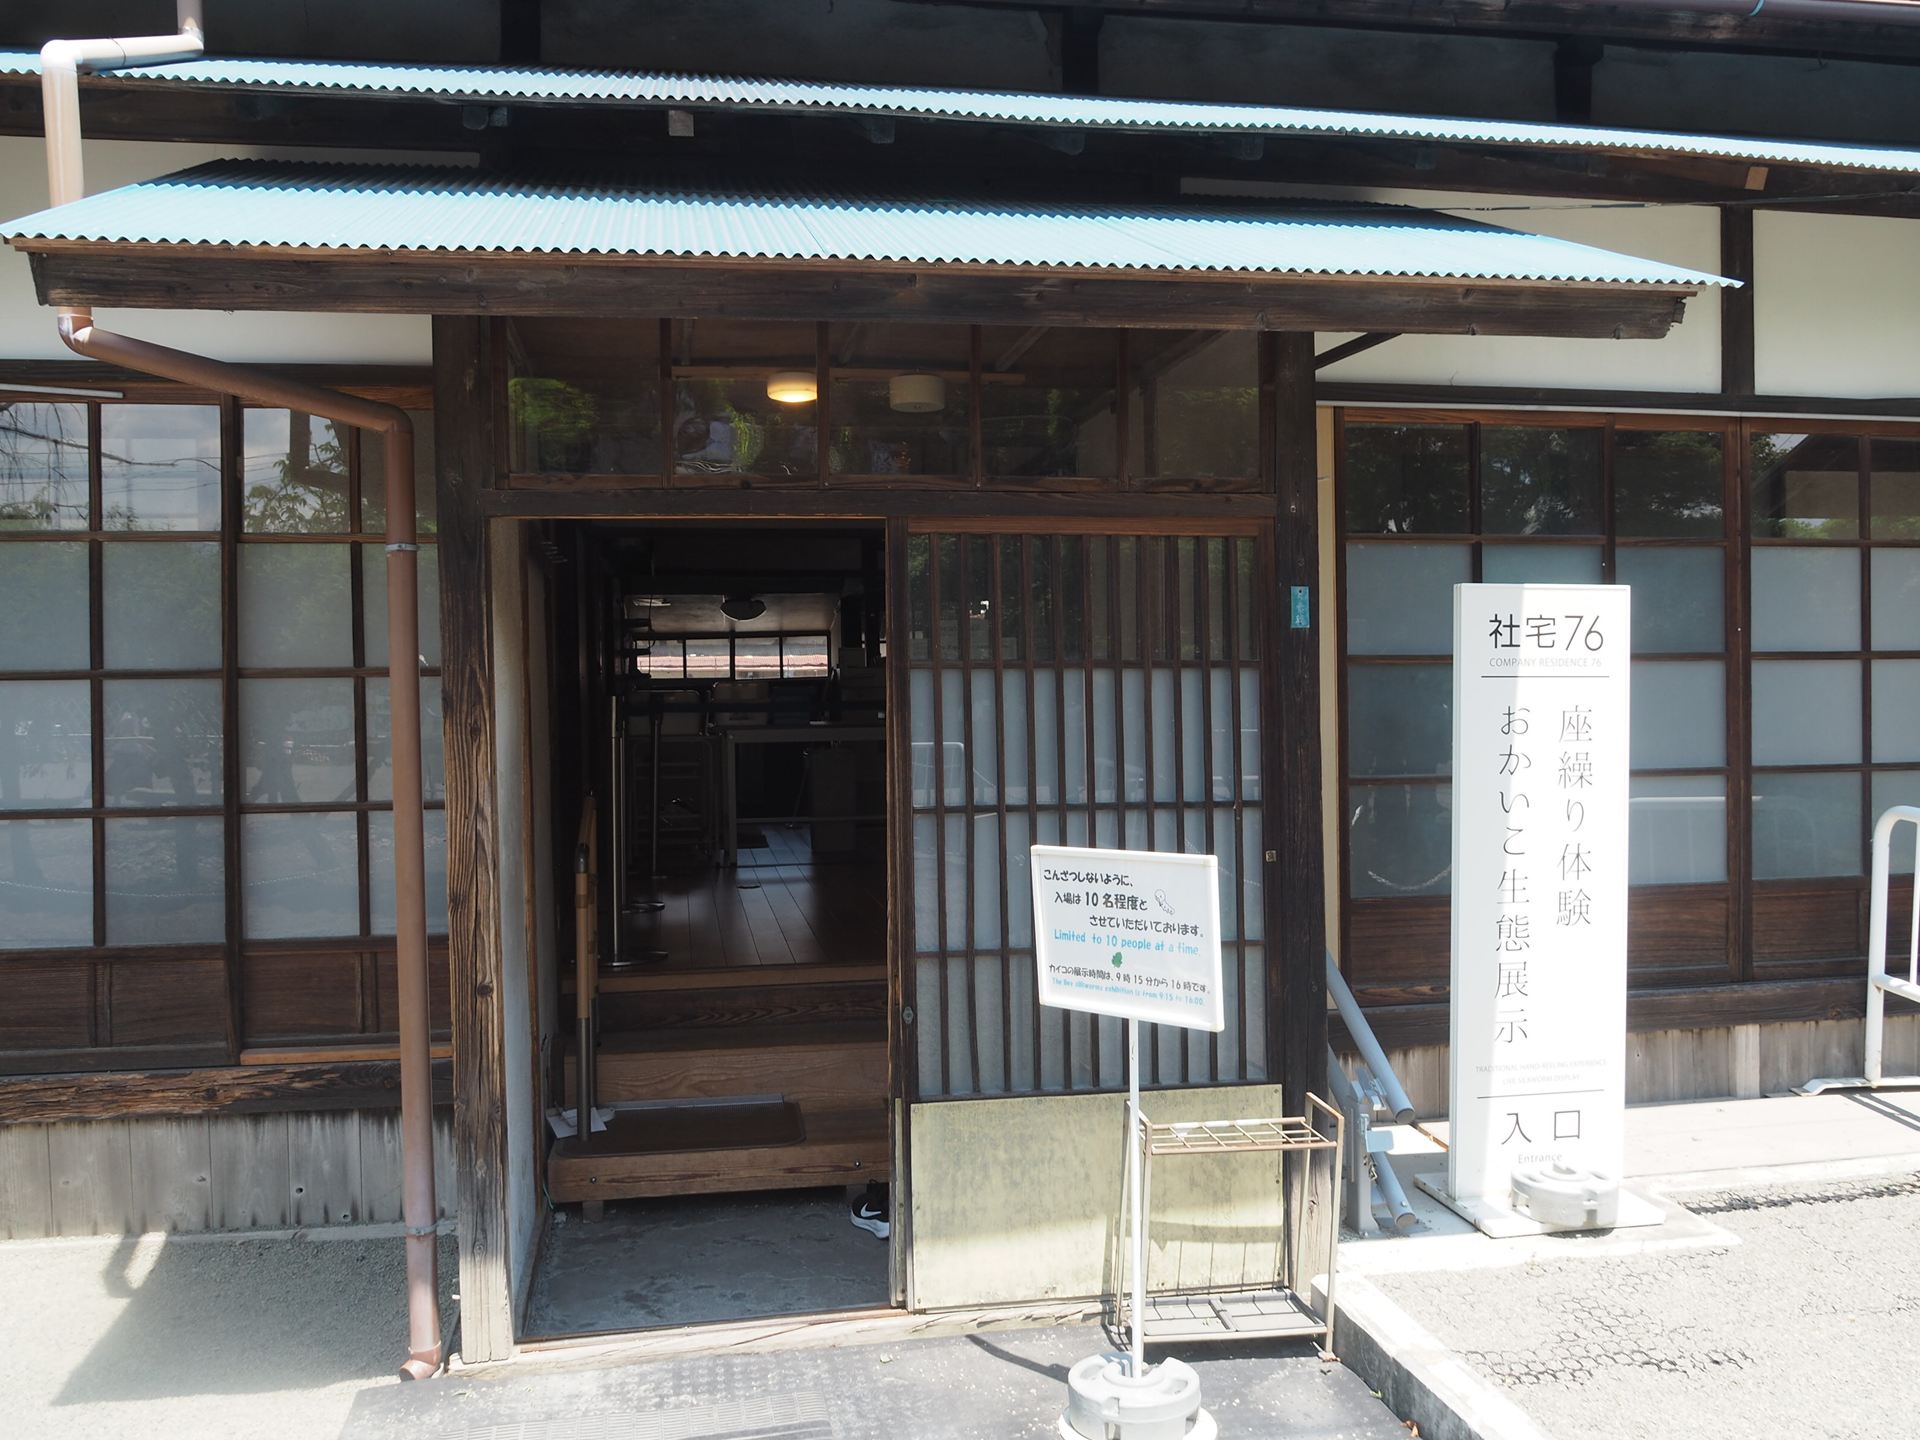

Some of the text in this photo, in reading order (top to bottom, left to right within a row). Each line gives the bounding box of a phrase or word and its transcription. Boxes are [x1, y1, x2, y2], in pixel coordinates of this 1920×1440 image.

[1489, 613, 1604, 652] 社宅76
[1489, 657, 1602, 668] COMPANY RESIDENCE 76
[1556, 705, 1593, 926] 座繰り体験
[1043, 869, 1133, 887] こんざつしないように、
[1495, 705, 1532, 1043] おかいこ生態展示
[1089, 914, 1204, 938] させていただいております。
[1054, 929, 1086, 943] Limited
[1092, 933, 1102, 944] to
[1106, 934, 1118, 947] 10
[1121, 938, 1152, 950] people
[1155, 940, 1164, 951] at
[1168, 944, 1175, 952] a
[1501, 1110, 1581, 1145] 入口
[1517, 1153, 1563, 1164] Entrance
